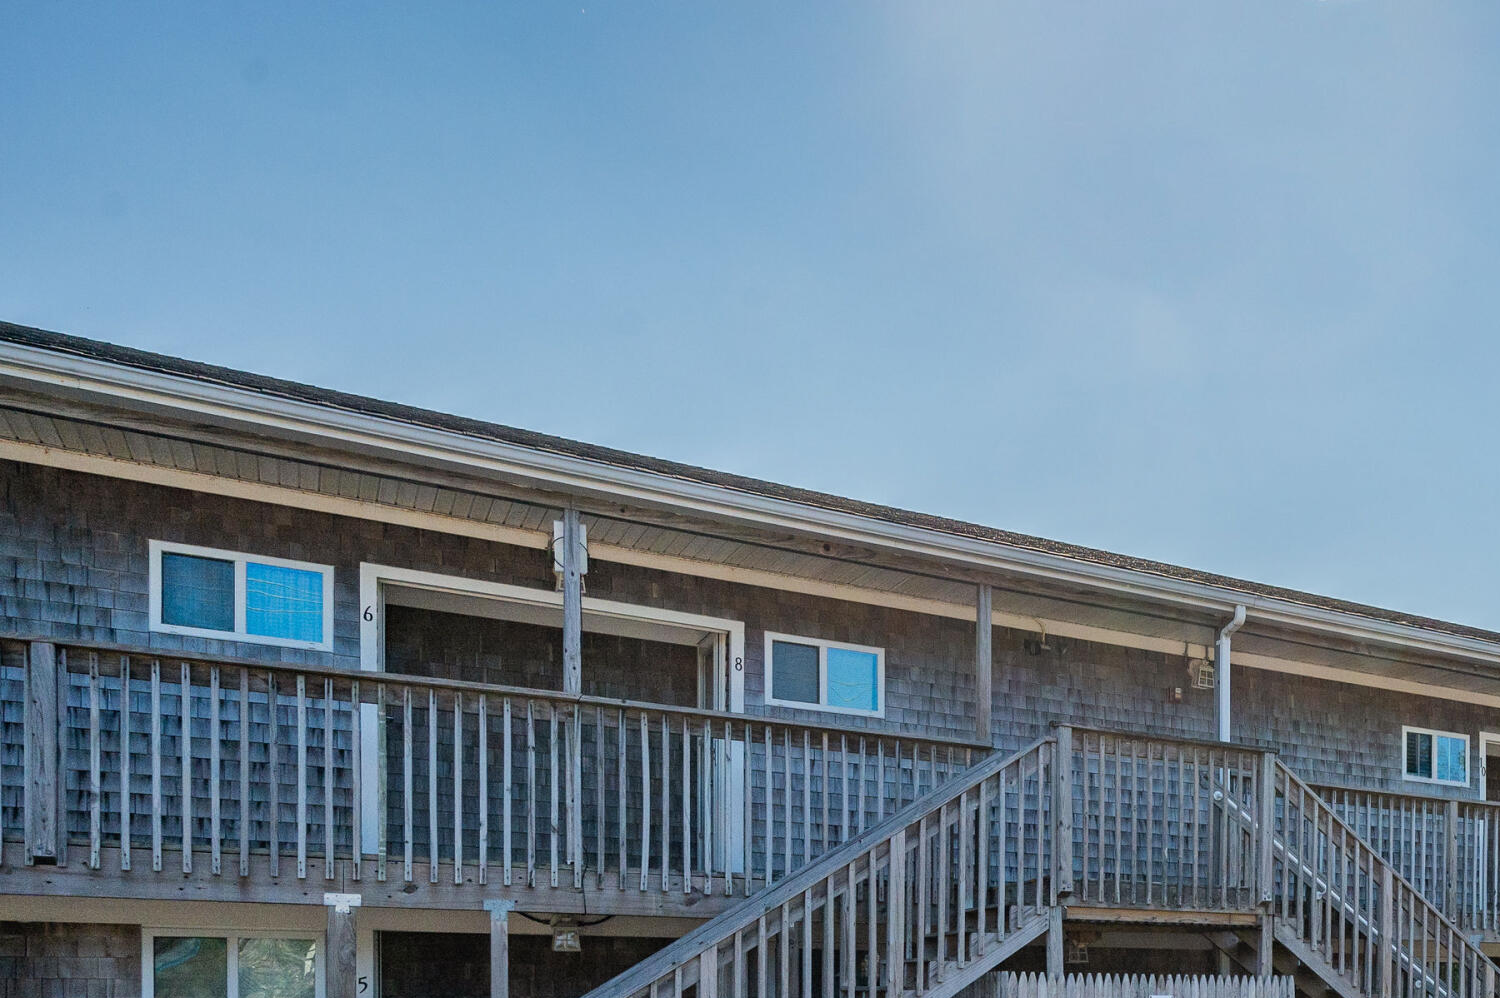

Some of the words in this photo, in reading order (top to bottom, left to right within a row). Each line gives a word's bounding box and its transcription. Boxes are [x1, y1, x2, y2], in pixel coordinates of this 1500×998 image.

[363, 605, 373, 622] 6
[735, 656, 743, 672] 8
[358, 976, 368, 994] 5
